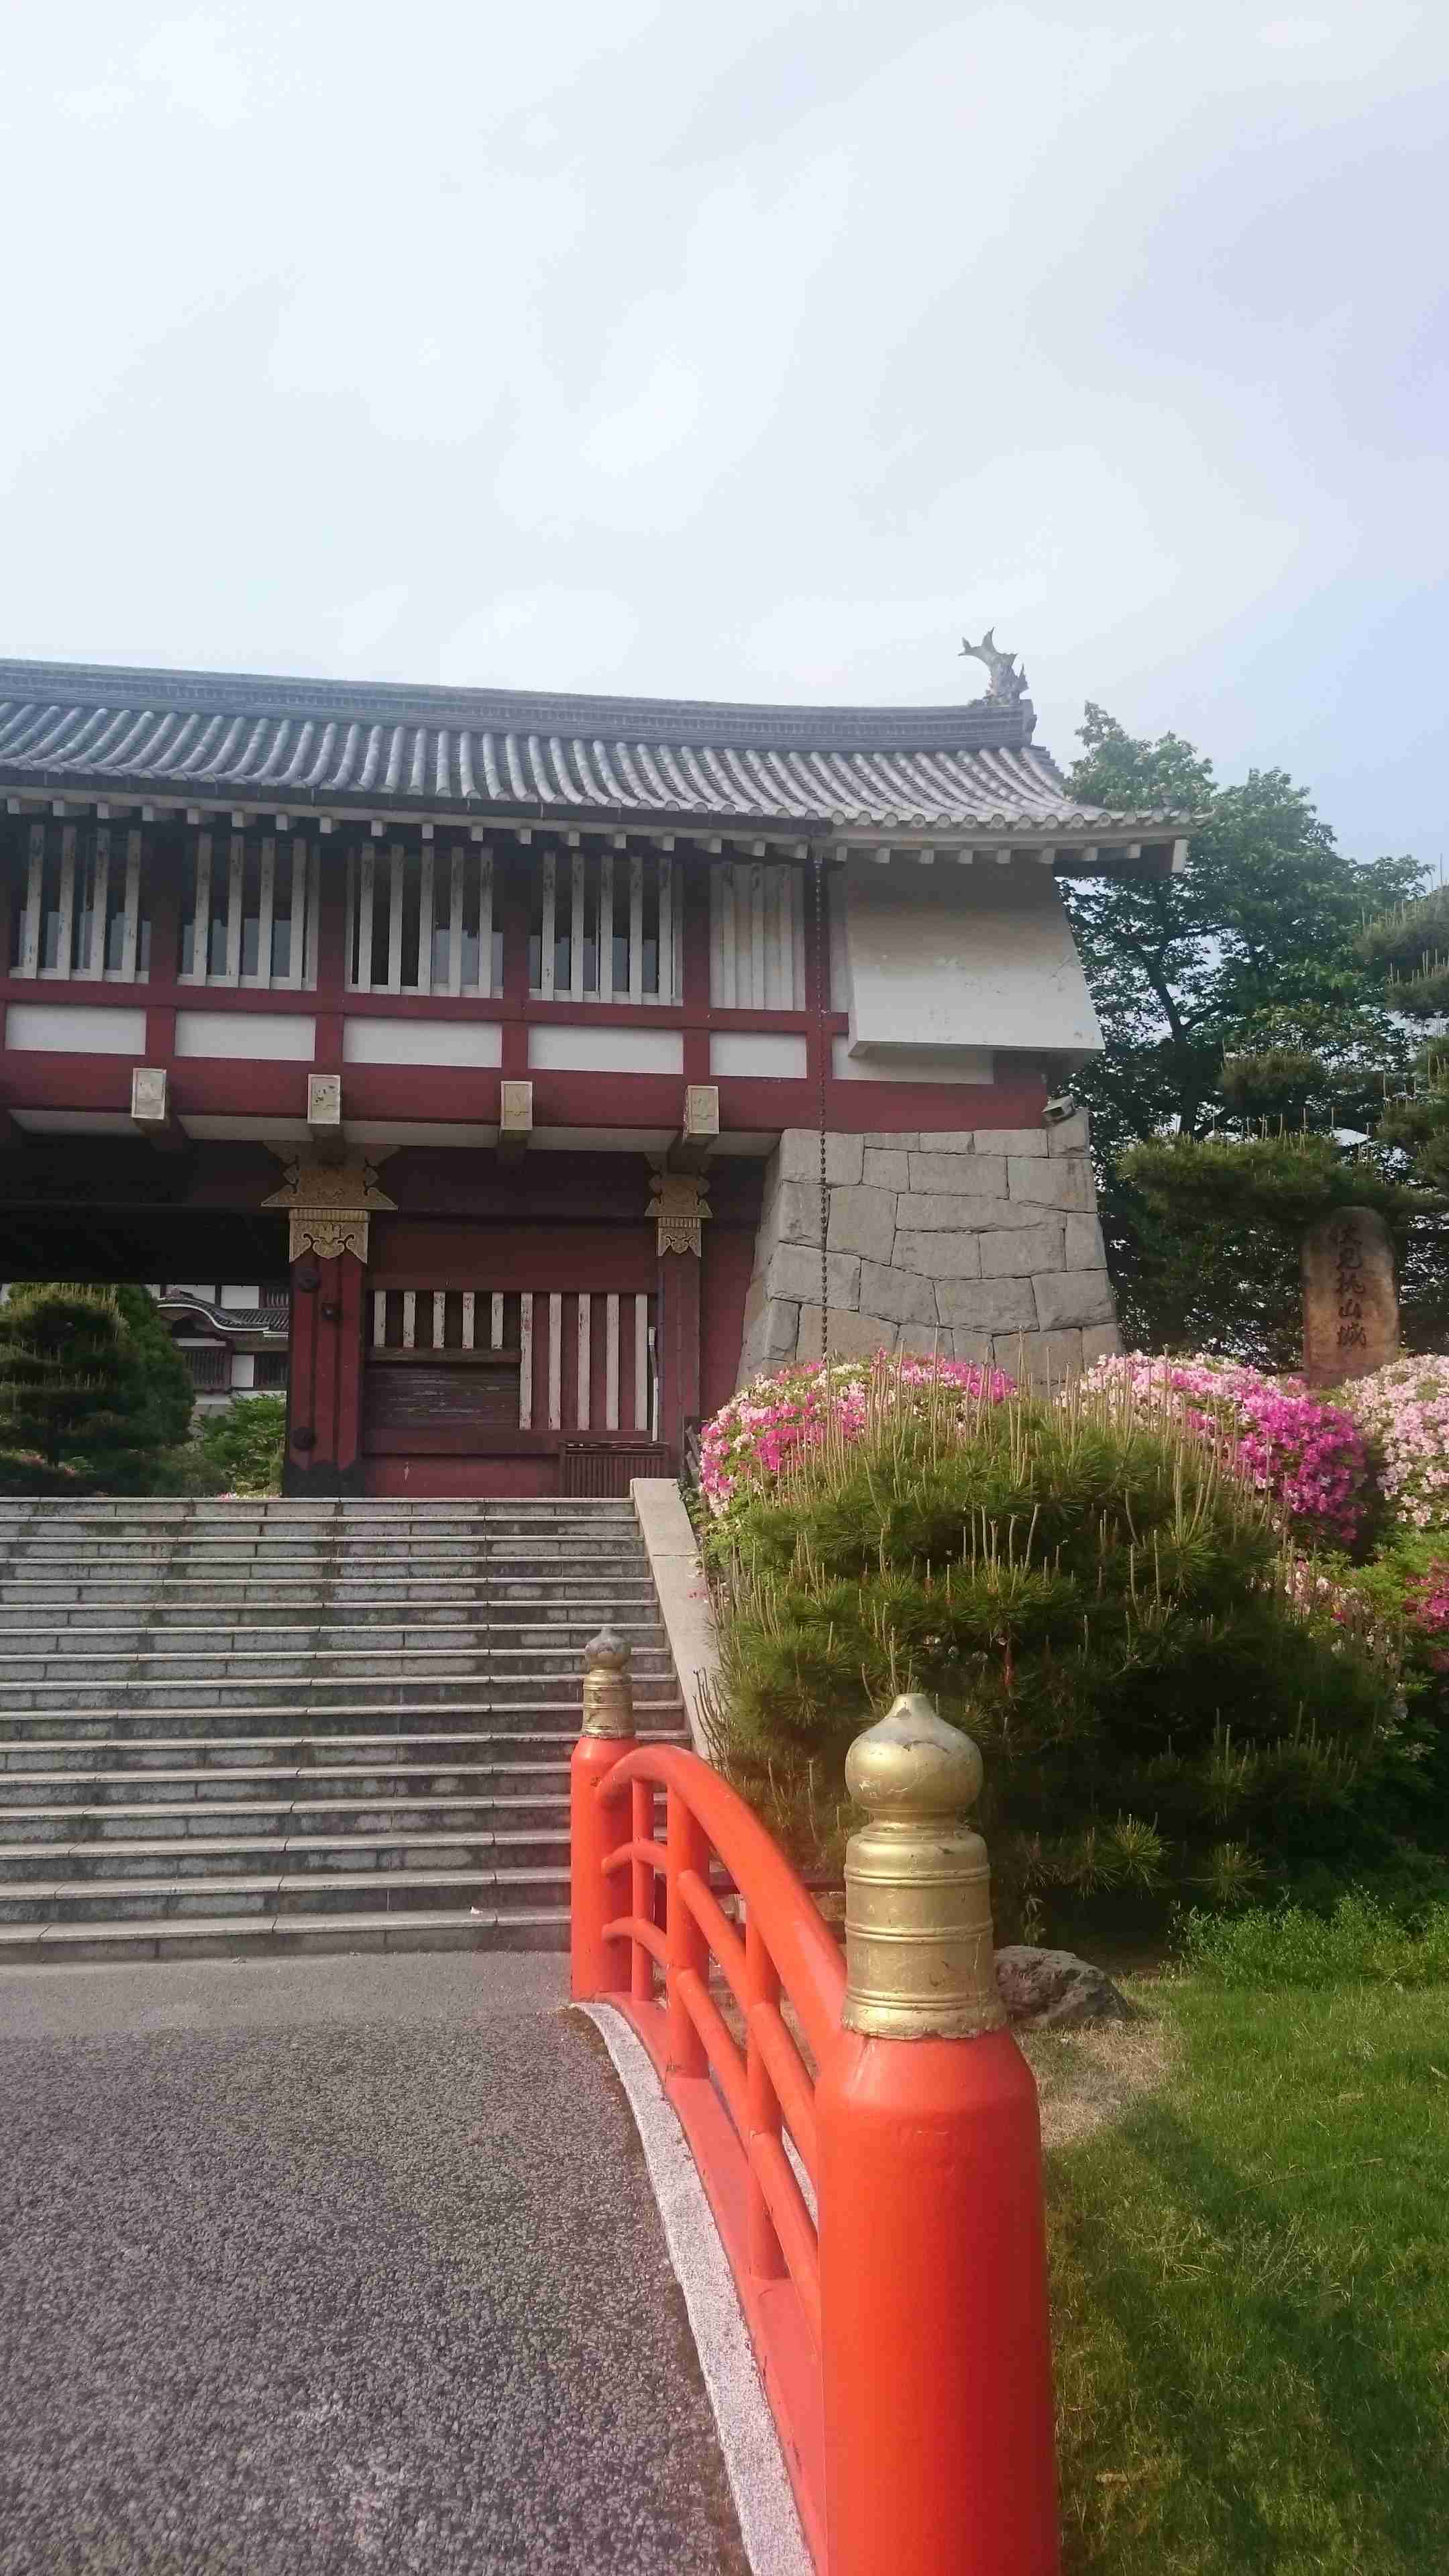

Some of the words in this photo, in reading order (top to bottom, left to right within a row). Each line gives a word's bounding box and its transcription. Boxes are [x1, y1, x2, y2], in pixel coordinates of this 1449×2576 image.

[1329, 1223, 1367, 1348] 伏見桃山城
